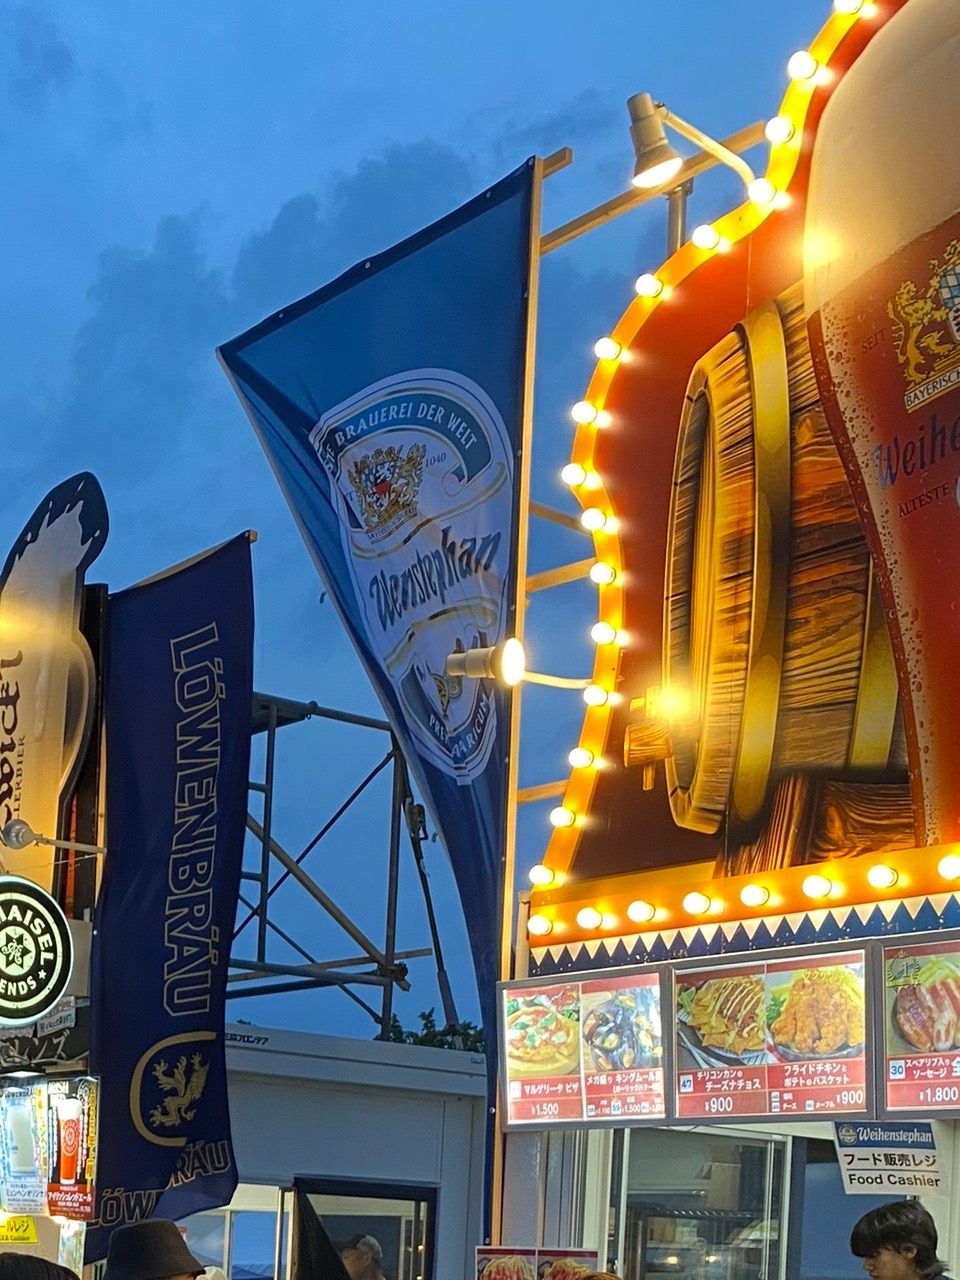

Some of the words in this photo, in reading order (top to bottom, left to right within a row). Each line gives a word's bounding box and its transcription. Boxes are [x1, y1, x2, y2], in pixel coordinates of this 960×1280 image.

[334, 402, 413, 447] BRAUEREI
[417, 402, 445, 424] DER
[447, 412, 477, 450] WELT
[899, 480, 950, 518] ÄLTESTE
[163, 621, 226, 1018] LÖWENBRÄU
[784, 1062, 848, 1077] フライドチキンと
[891, 1065, 904, 1075] 30
[913, 1067, 947, 1078] ソーセージ
[681, 1079, 692, 1089] 47
[705, 1079, 761, 1092] チーズナチョス
[836, 1090, 863, 1105] ¥900
[919, 1086, 959, 1102] ¥1,800
[531, 1102, 559, 1115] ¥1,500
[704, 1097, 734, 1113] ¥900
[856, 1126, 932, 1144] Weihenstephan
[843, 1152, 937, 1168] フード販売レジ
[848, 1173, 884, 1186] Food
[887, 1174, 941, 1188] Cashier
